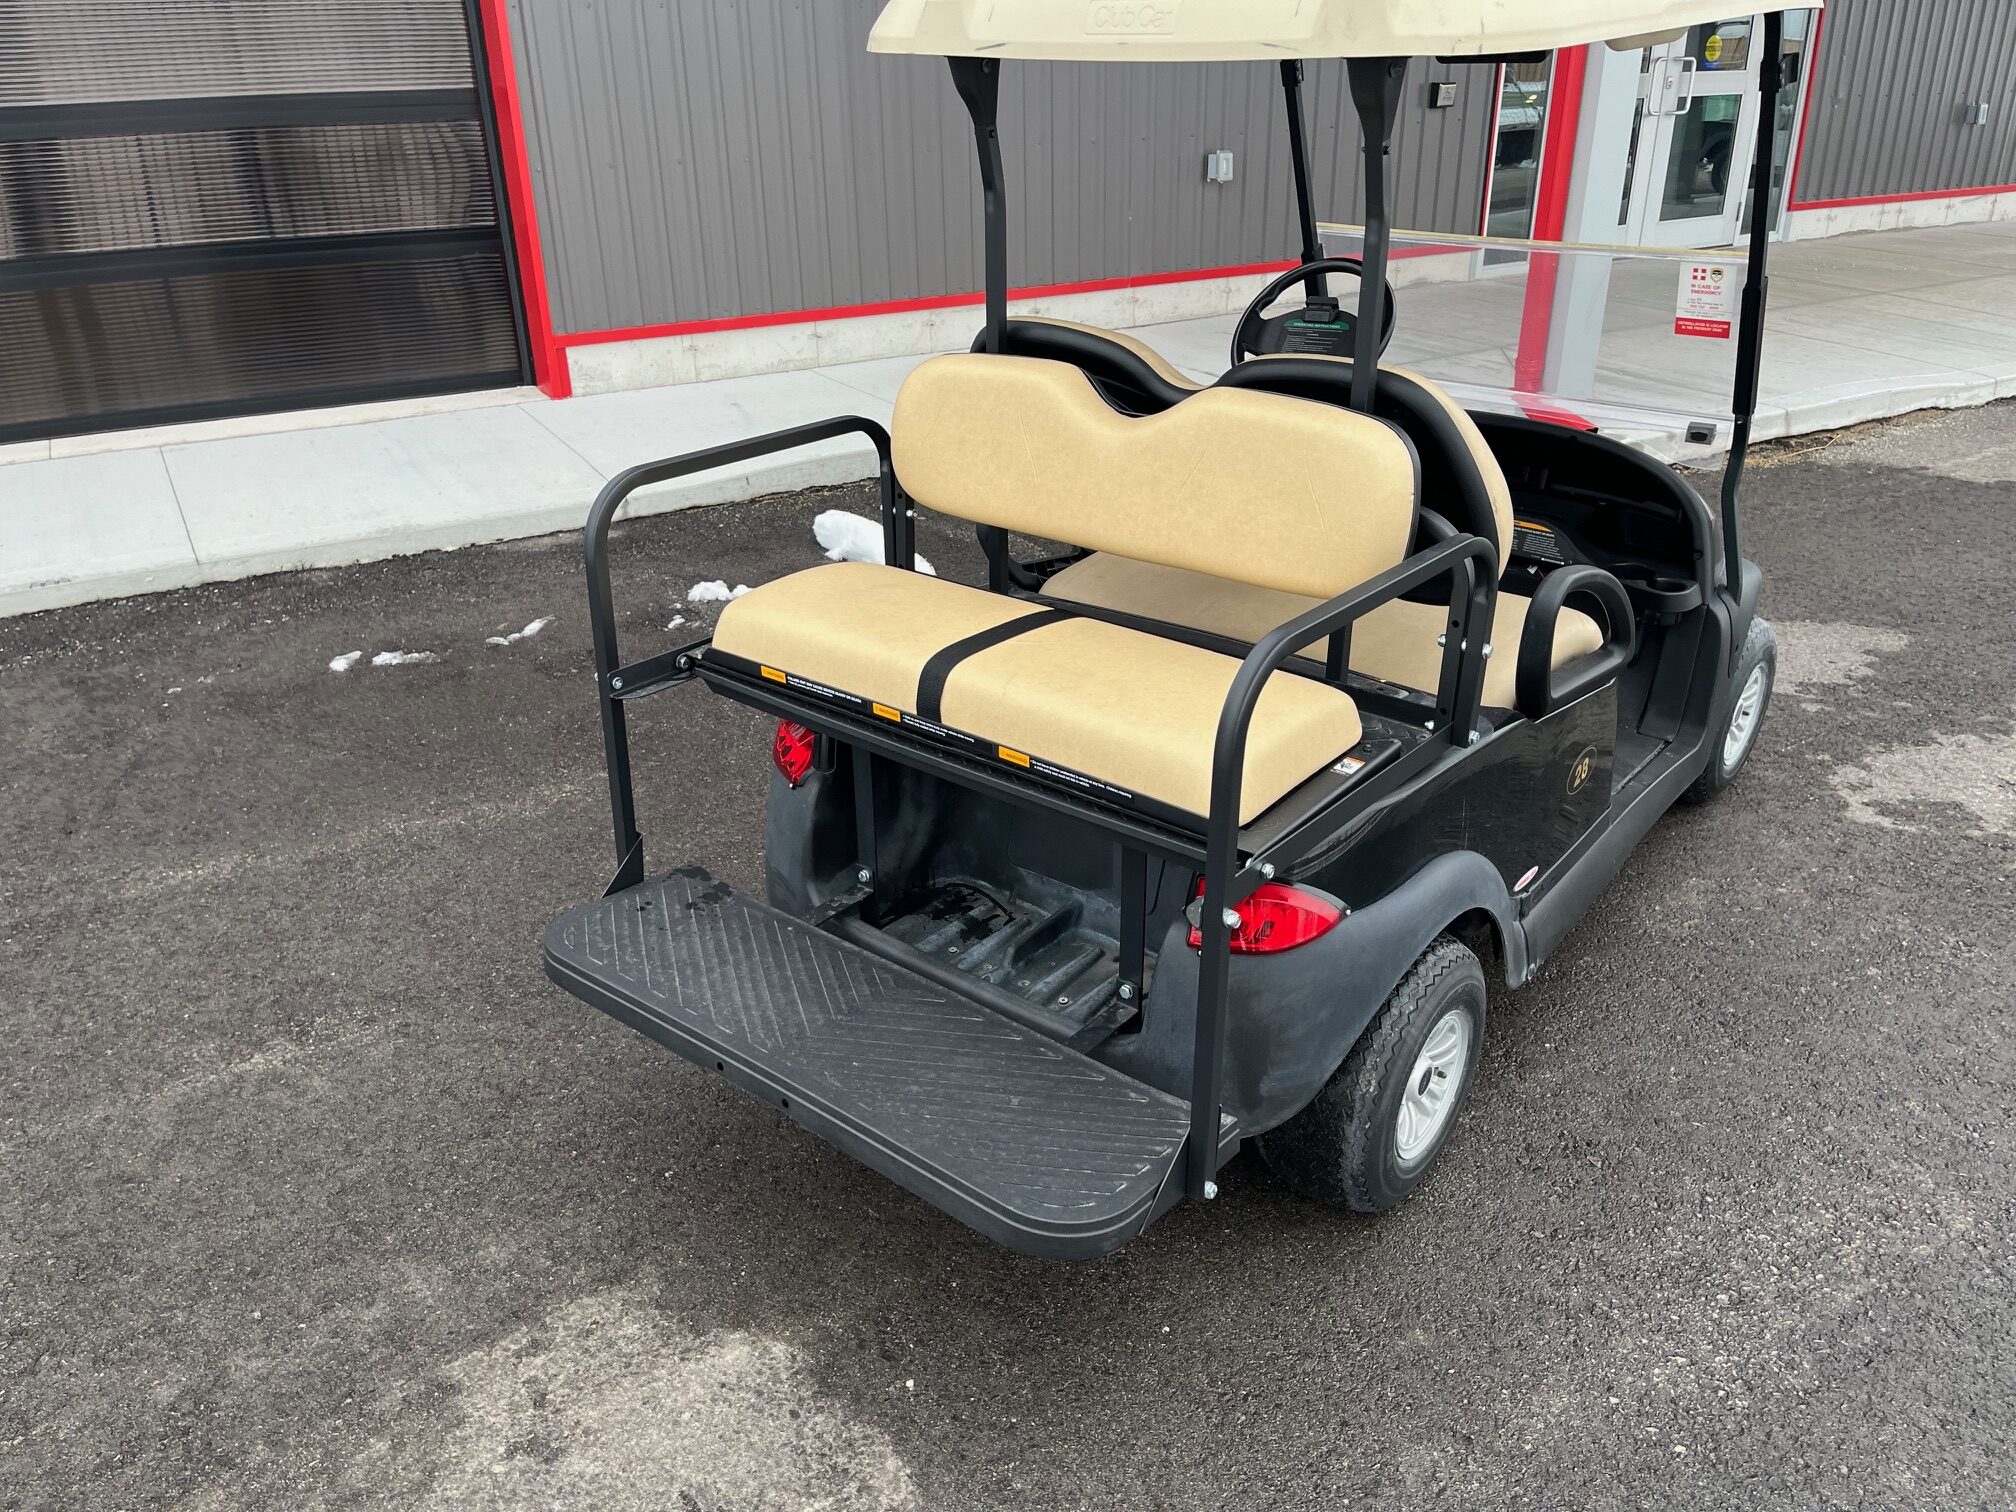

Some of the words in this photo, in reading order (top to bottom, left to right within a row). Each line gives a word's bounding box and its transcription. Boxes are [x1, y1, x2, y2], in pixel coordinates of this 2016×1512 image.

[1094, 5, 1136, 28] Club
[1138, 4, 1174, 28] Car
[1005, 752, 1028, 765] WARNING
[1574, 757, 1590, 789] 28
